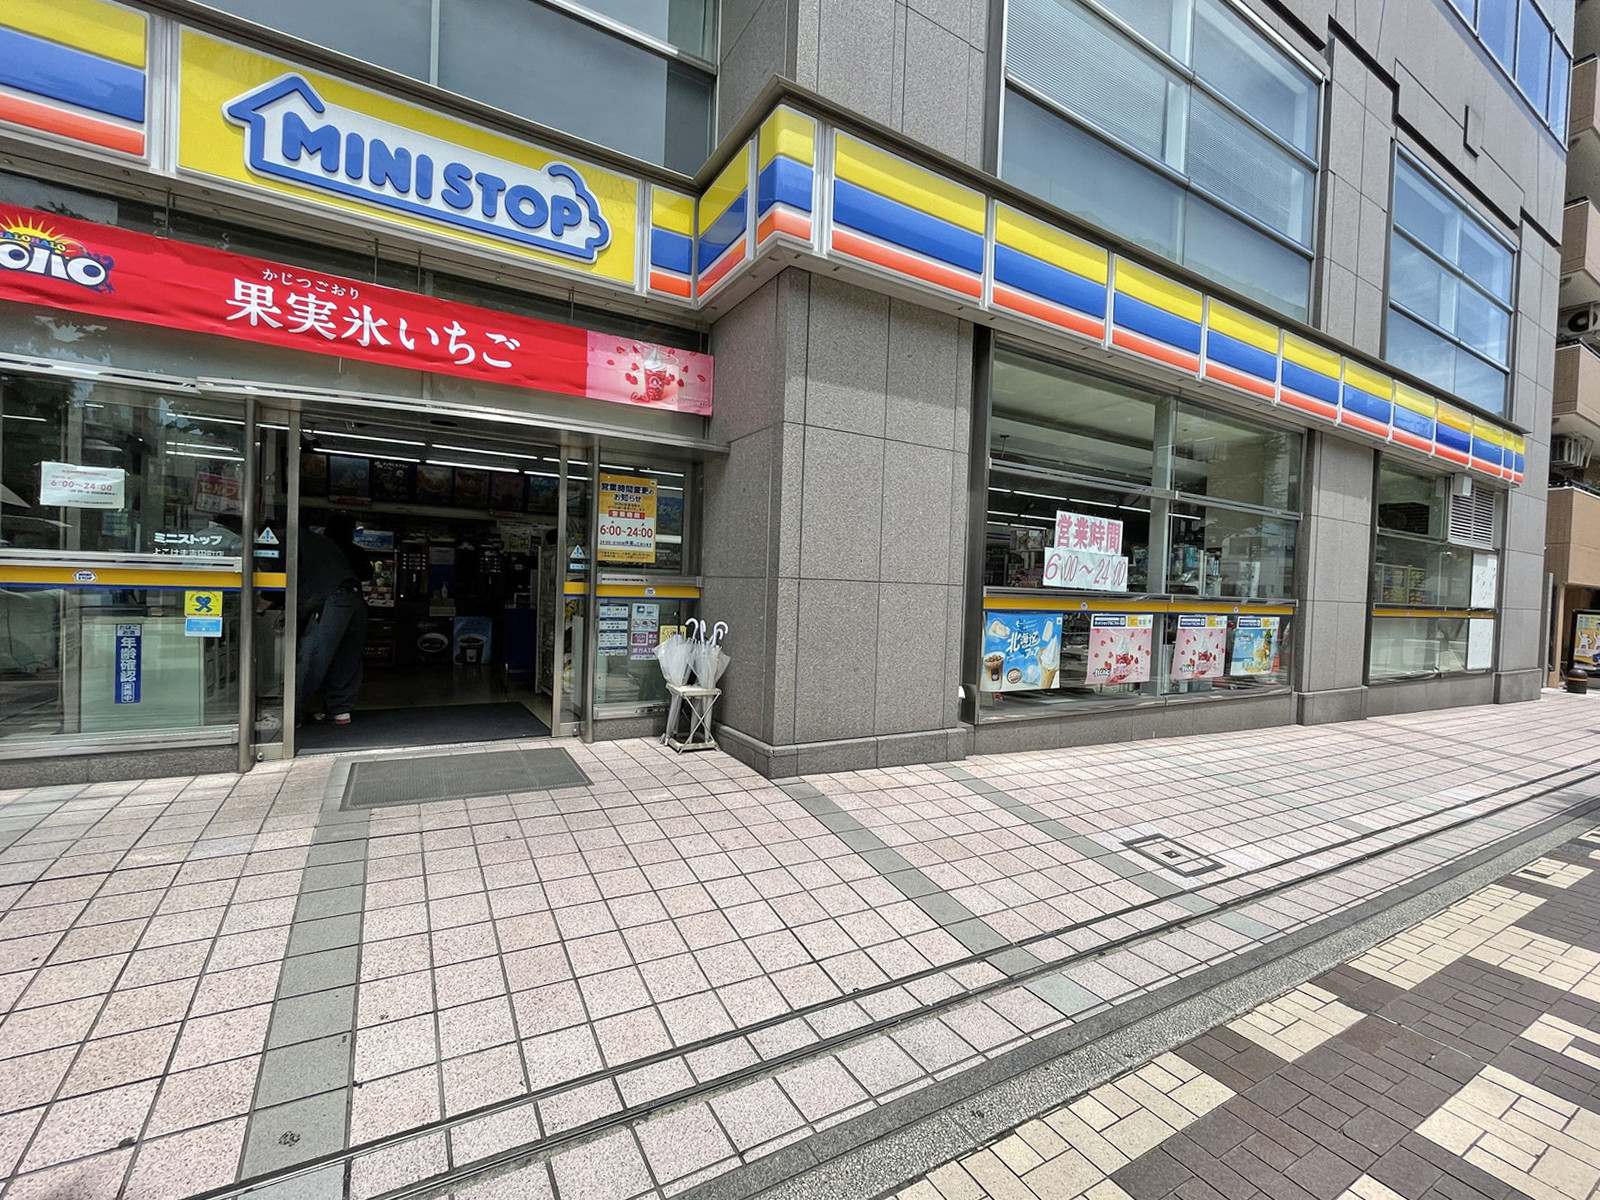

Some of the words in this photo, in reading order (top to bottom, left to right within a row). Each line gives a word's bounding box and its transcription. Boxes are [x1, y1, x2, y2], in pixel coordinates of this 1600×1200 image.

[282, 112, 582, 237] MINISTOP
[262, 268, 359, 300] かじつごおり
[226, 278, 520, 368] 果実氷いちご
[614, 493, 641, 502] お知らせ
[154, 532, 222, 545] ミニストップ
[1057, 514, 1121, 554] 営業時間
[120, 637, 136, 682] 年齢確認
[1006, 631, 1040, 653] 北海道
